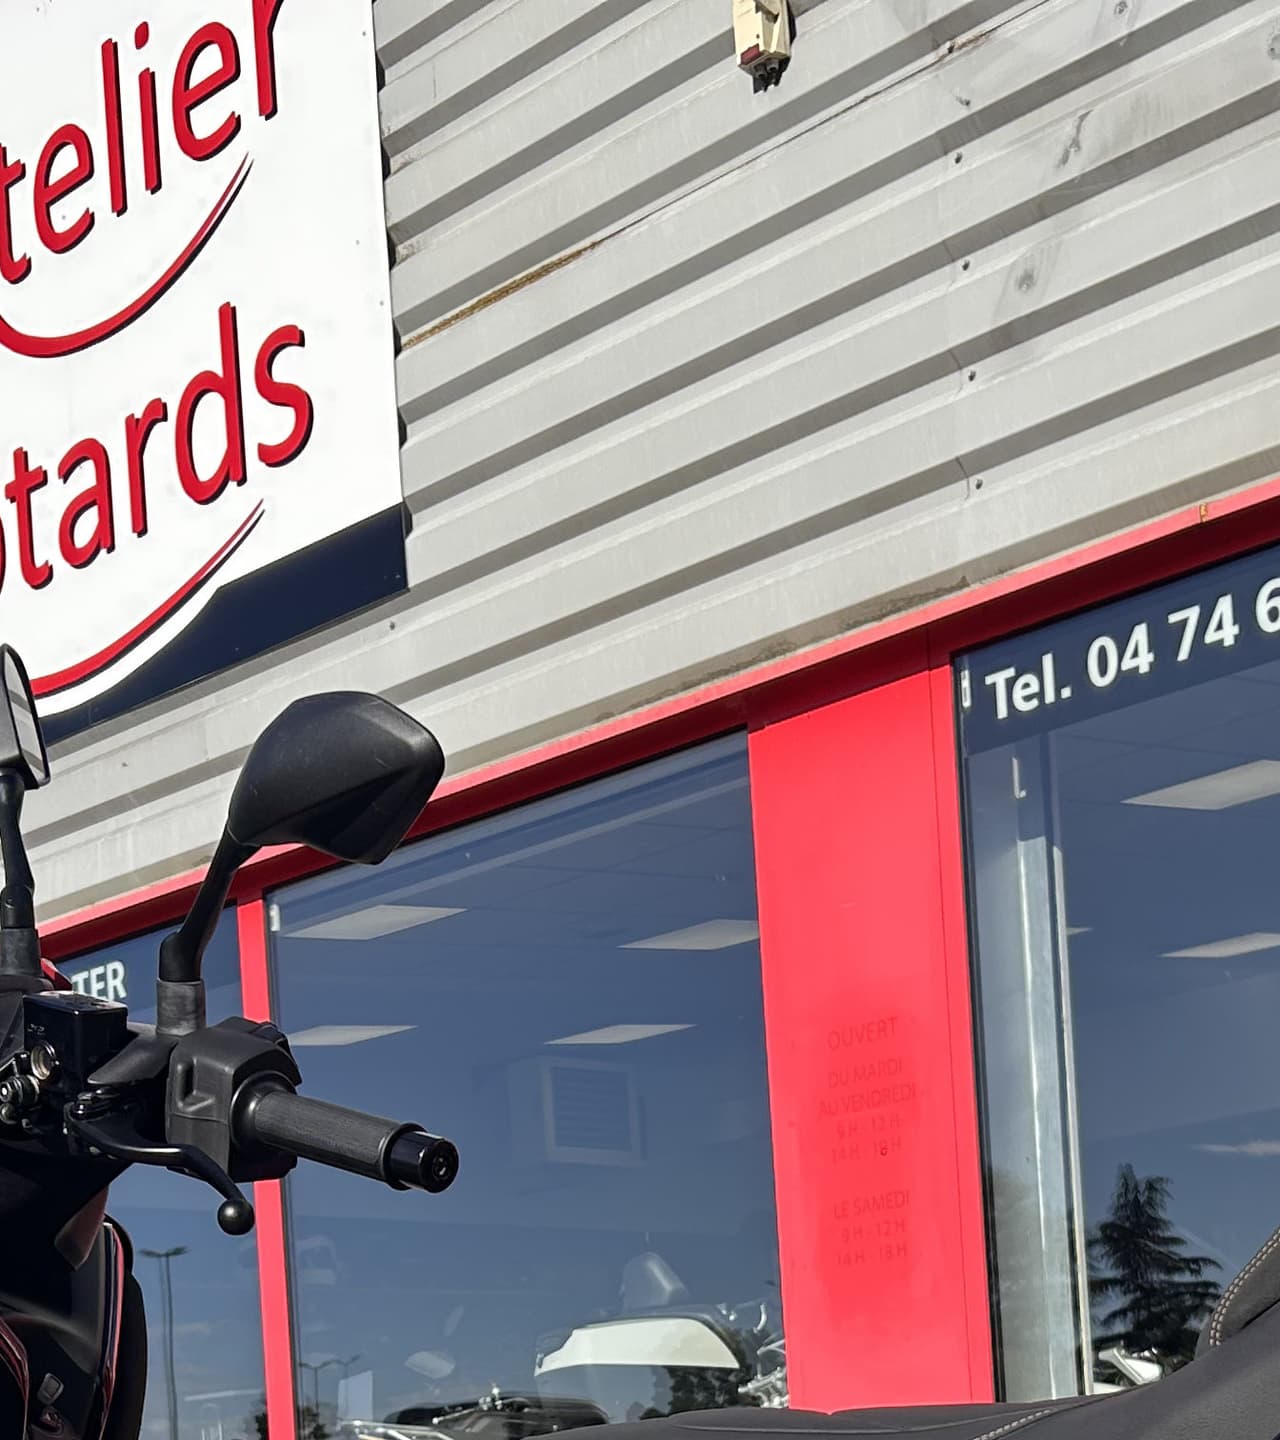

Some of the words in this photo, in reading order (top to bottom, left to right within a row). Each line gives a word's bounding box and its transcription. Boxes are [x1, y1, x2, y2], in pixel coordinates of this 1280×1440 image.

[984, 652, 1072, 721] Tel.
[1087, 622, 1154, 690] 04
[1167, 593, 1240, 664] 74
[827, 1015, 898, 1051] OUVERT
[828, 1067, 850, 1089] DU
[853, 1056, 904, 1083] MARDI
[840, 1082, 917, 1113] VENDREDI
[832, 1200, 850, 1220] LE
[853, 1188, 911, 1217] SAMEDI
